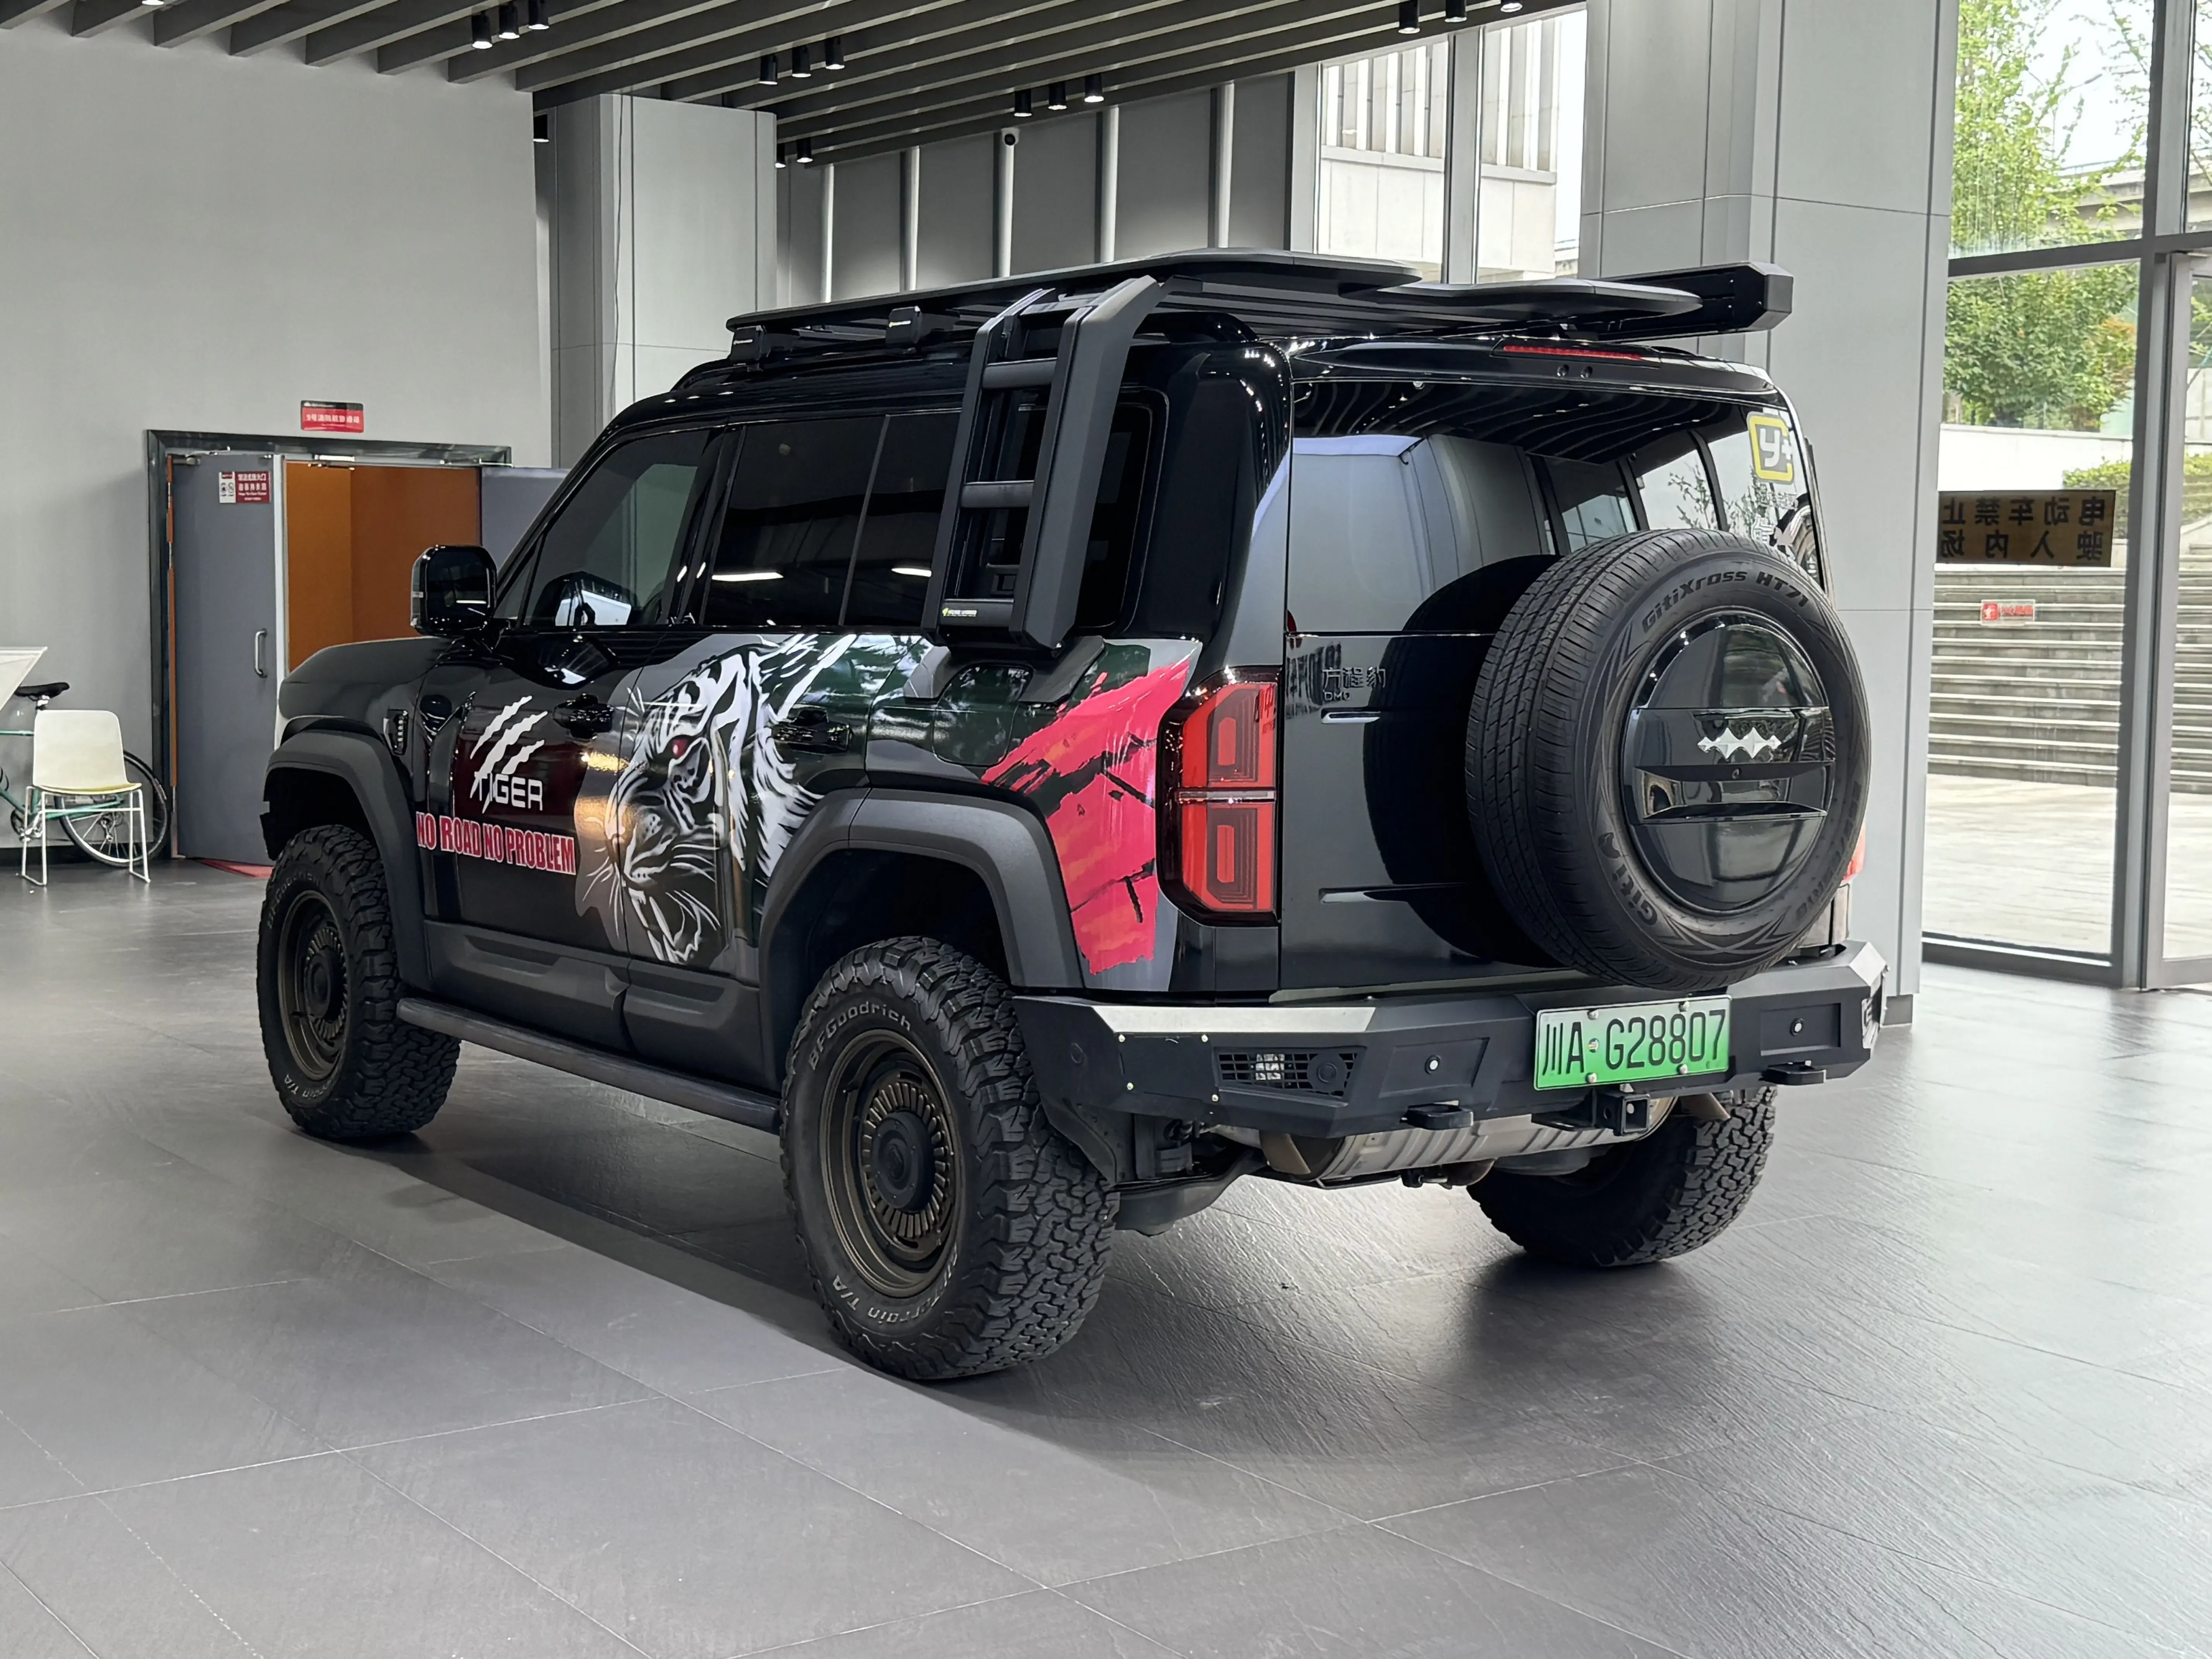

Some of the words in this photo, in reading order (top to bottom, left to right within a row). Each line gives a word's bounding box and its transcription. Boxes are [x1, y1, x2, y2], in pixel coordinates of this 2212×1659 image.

[1756, 571, 1809, 608] HT71
[416, 811, 437, 850] NO
[439, 815, 482, 857] ROAD
[483, 823, 503, 863] NO
[505, 827, 577, 875] PROBLEM
[809, 1001, 910, 1070] BFGoodrich
[833, 1275, 860, 1310] T/A
